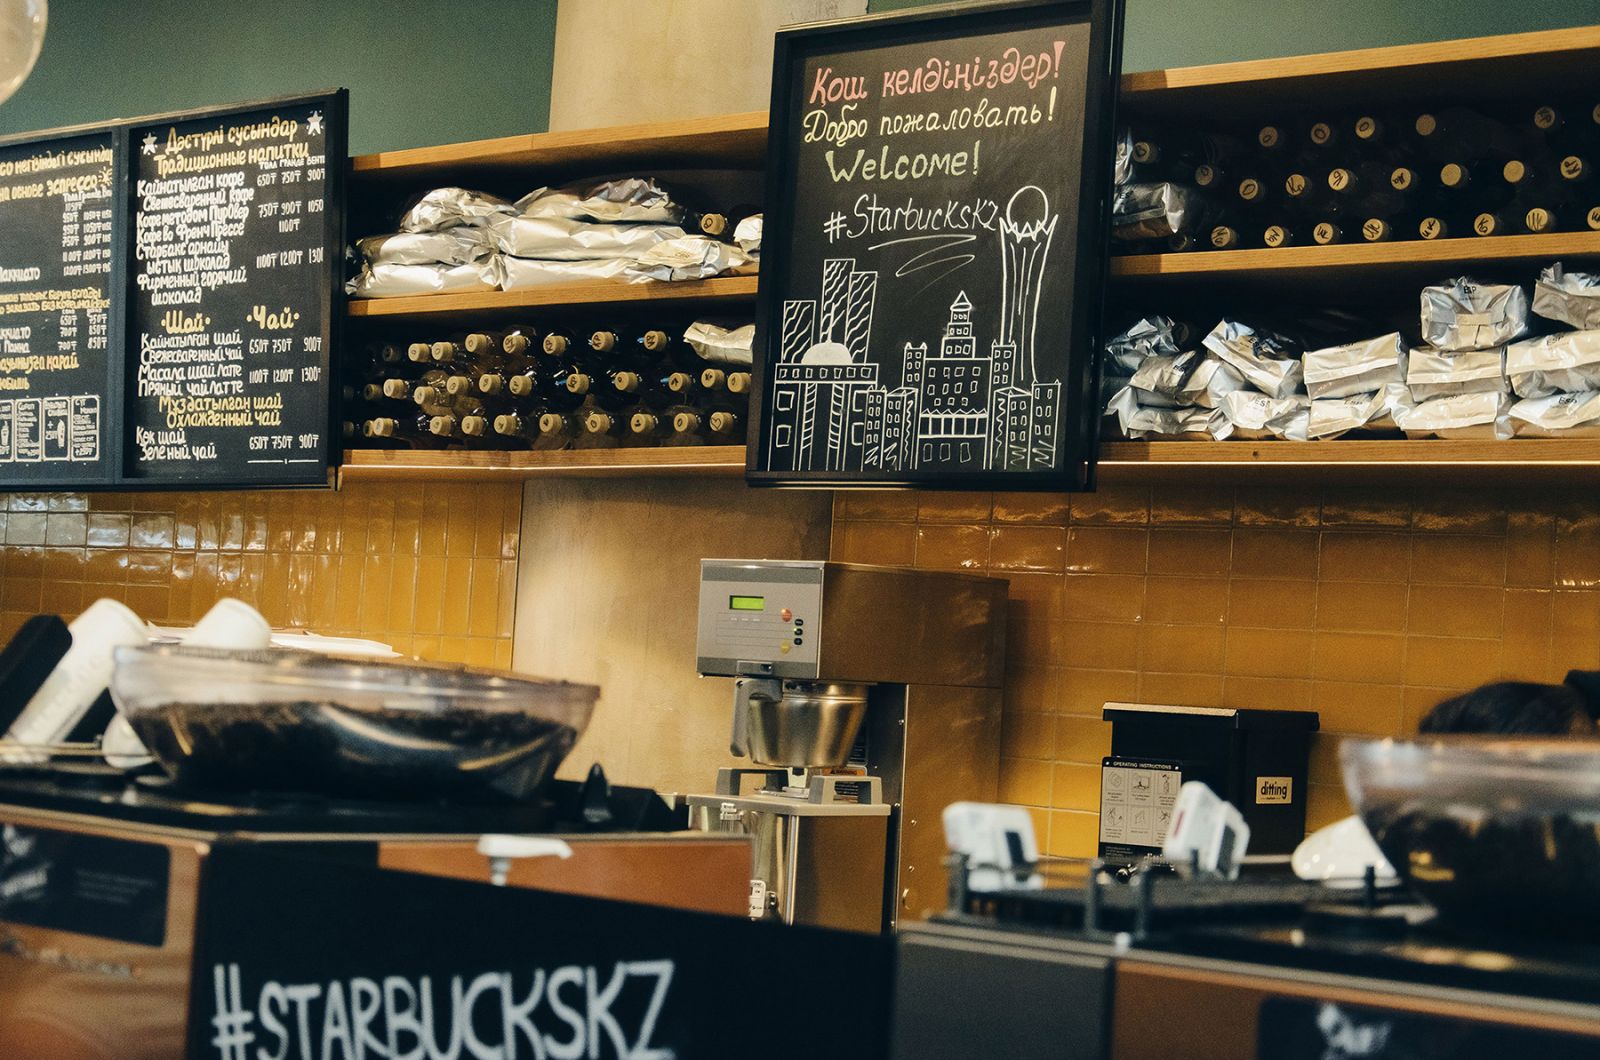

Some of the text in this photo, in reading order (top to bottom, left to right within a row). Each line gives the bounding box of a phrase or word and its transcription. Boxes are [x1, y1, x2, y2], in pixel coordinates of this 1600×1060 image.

[803, 86, 1057, 147] Добро пожаловать!
[227, 116, 298, 146] сусындар
[153, 142, 309, 178] Традиционные напитки
[825, 140, 981, 182] Welcome!
[216, 171, 246, 189] кофе
[229, 187, 255, 205] кофе
[136, 212, 162, 231] Кофе
[162, 207, 208, 226] методом
[136, 221, 245, 246] Кофе во Френч Прессе
[136, 241, 187, 260] Старбакс
[183, 253, 231, 272] шоколад
[137, 265, 248, 291] Фирменный горячий
[151, 286, 202, 306] шоколад
[213, 328, 243, 346] шай
[140, 346, 243, 366] Свежесваренный чай
[138, 364, 186, 381] Масала
[187, 362, 216, 379] шай
[138, 379, 183, 397] Пряный
[186, 380, 209, 396] чай
[253, 392, 283, 410] шай
[166, 410, 282, 429] Охлажденный чай
[158, 427, 186, 445] шай
[192, 441, 218, 461] чай
[1261, 781, 1288, 799] ditting
[212, 961, 674, 1060] #STARBUCKSKZ
